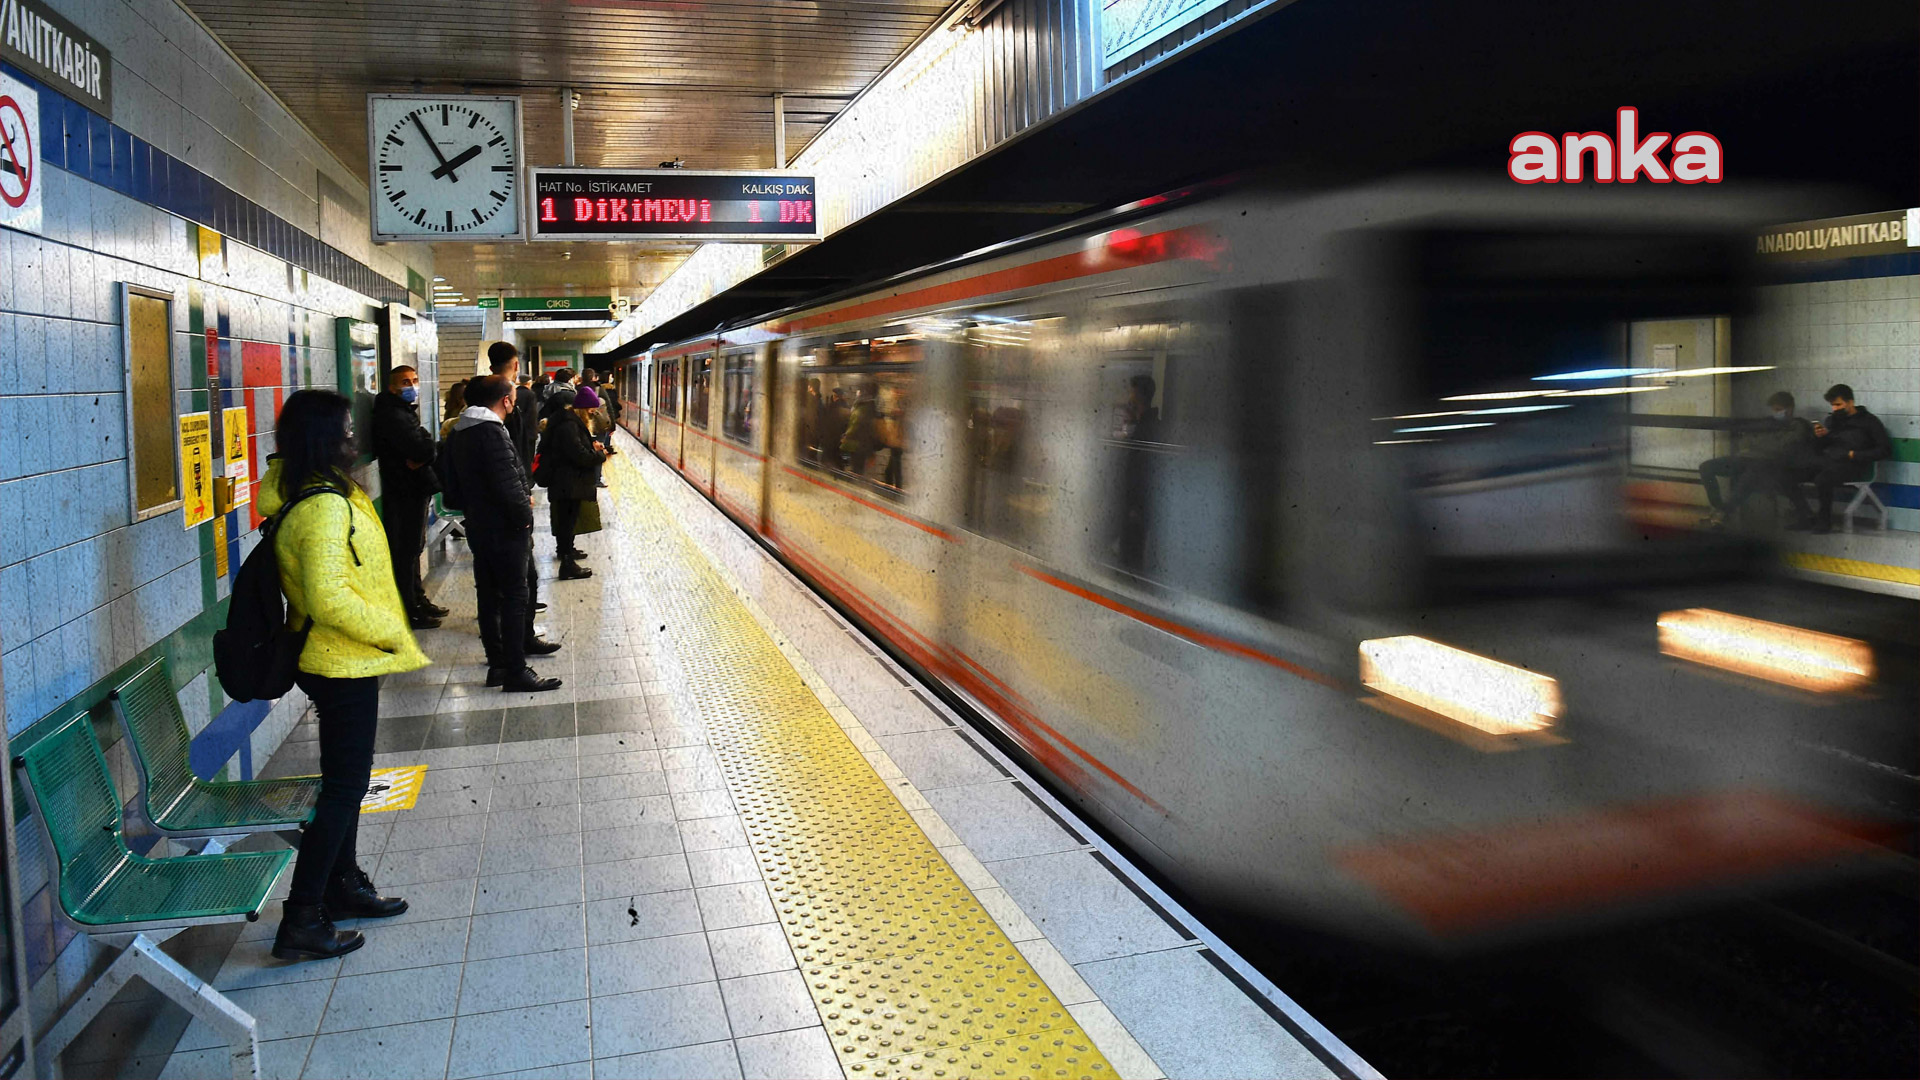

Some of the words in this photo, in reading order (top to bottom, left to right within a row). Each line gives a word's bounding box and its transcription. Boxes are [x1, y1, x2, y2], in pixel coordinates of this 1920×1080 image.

[539, 182, 562, 192] HAT
[565, 182, 585, 192] No.
[588, 180, 653, 193] İSTİKAMET
[742, 184, 783, 196] KALKIŞ
[786, 184, 813, 195] DAK.
[541, 198, 558, 221] 1
[747, 199, 764, 223] 1
[778, 200, 813, 223] DK
